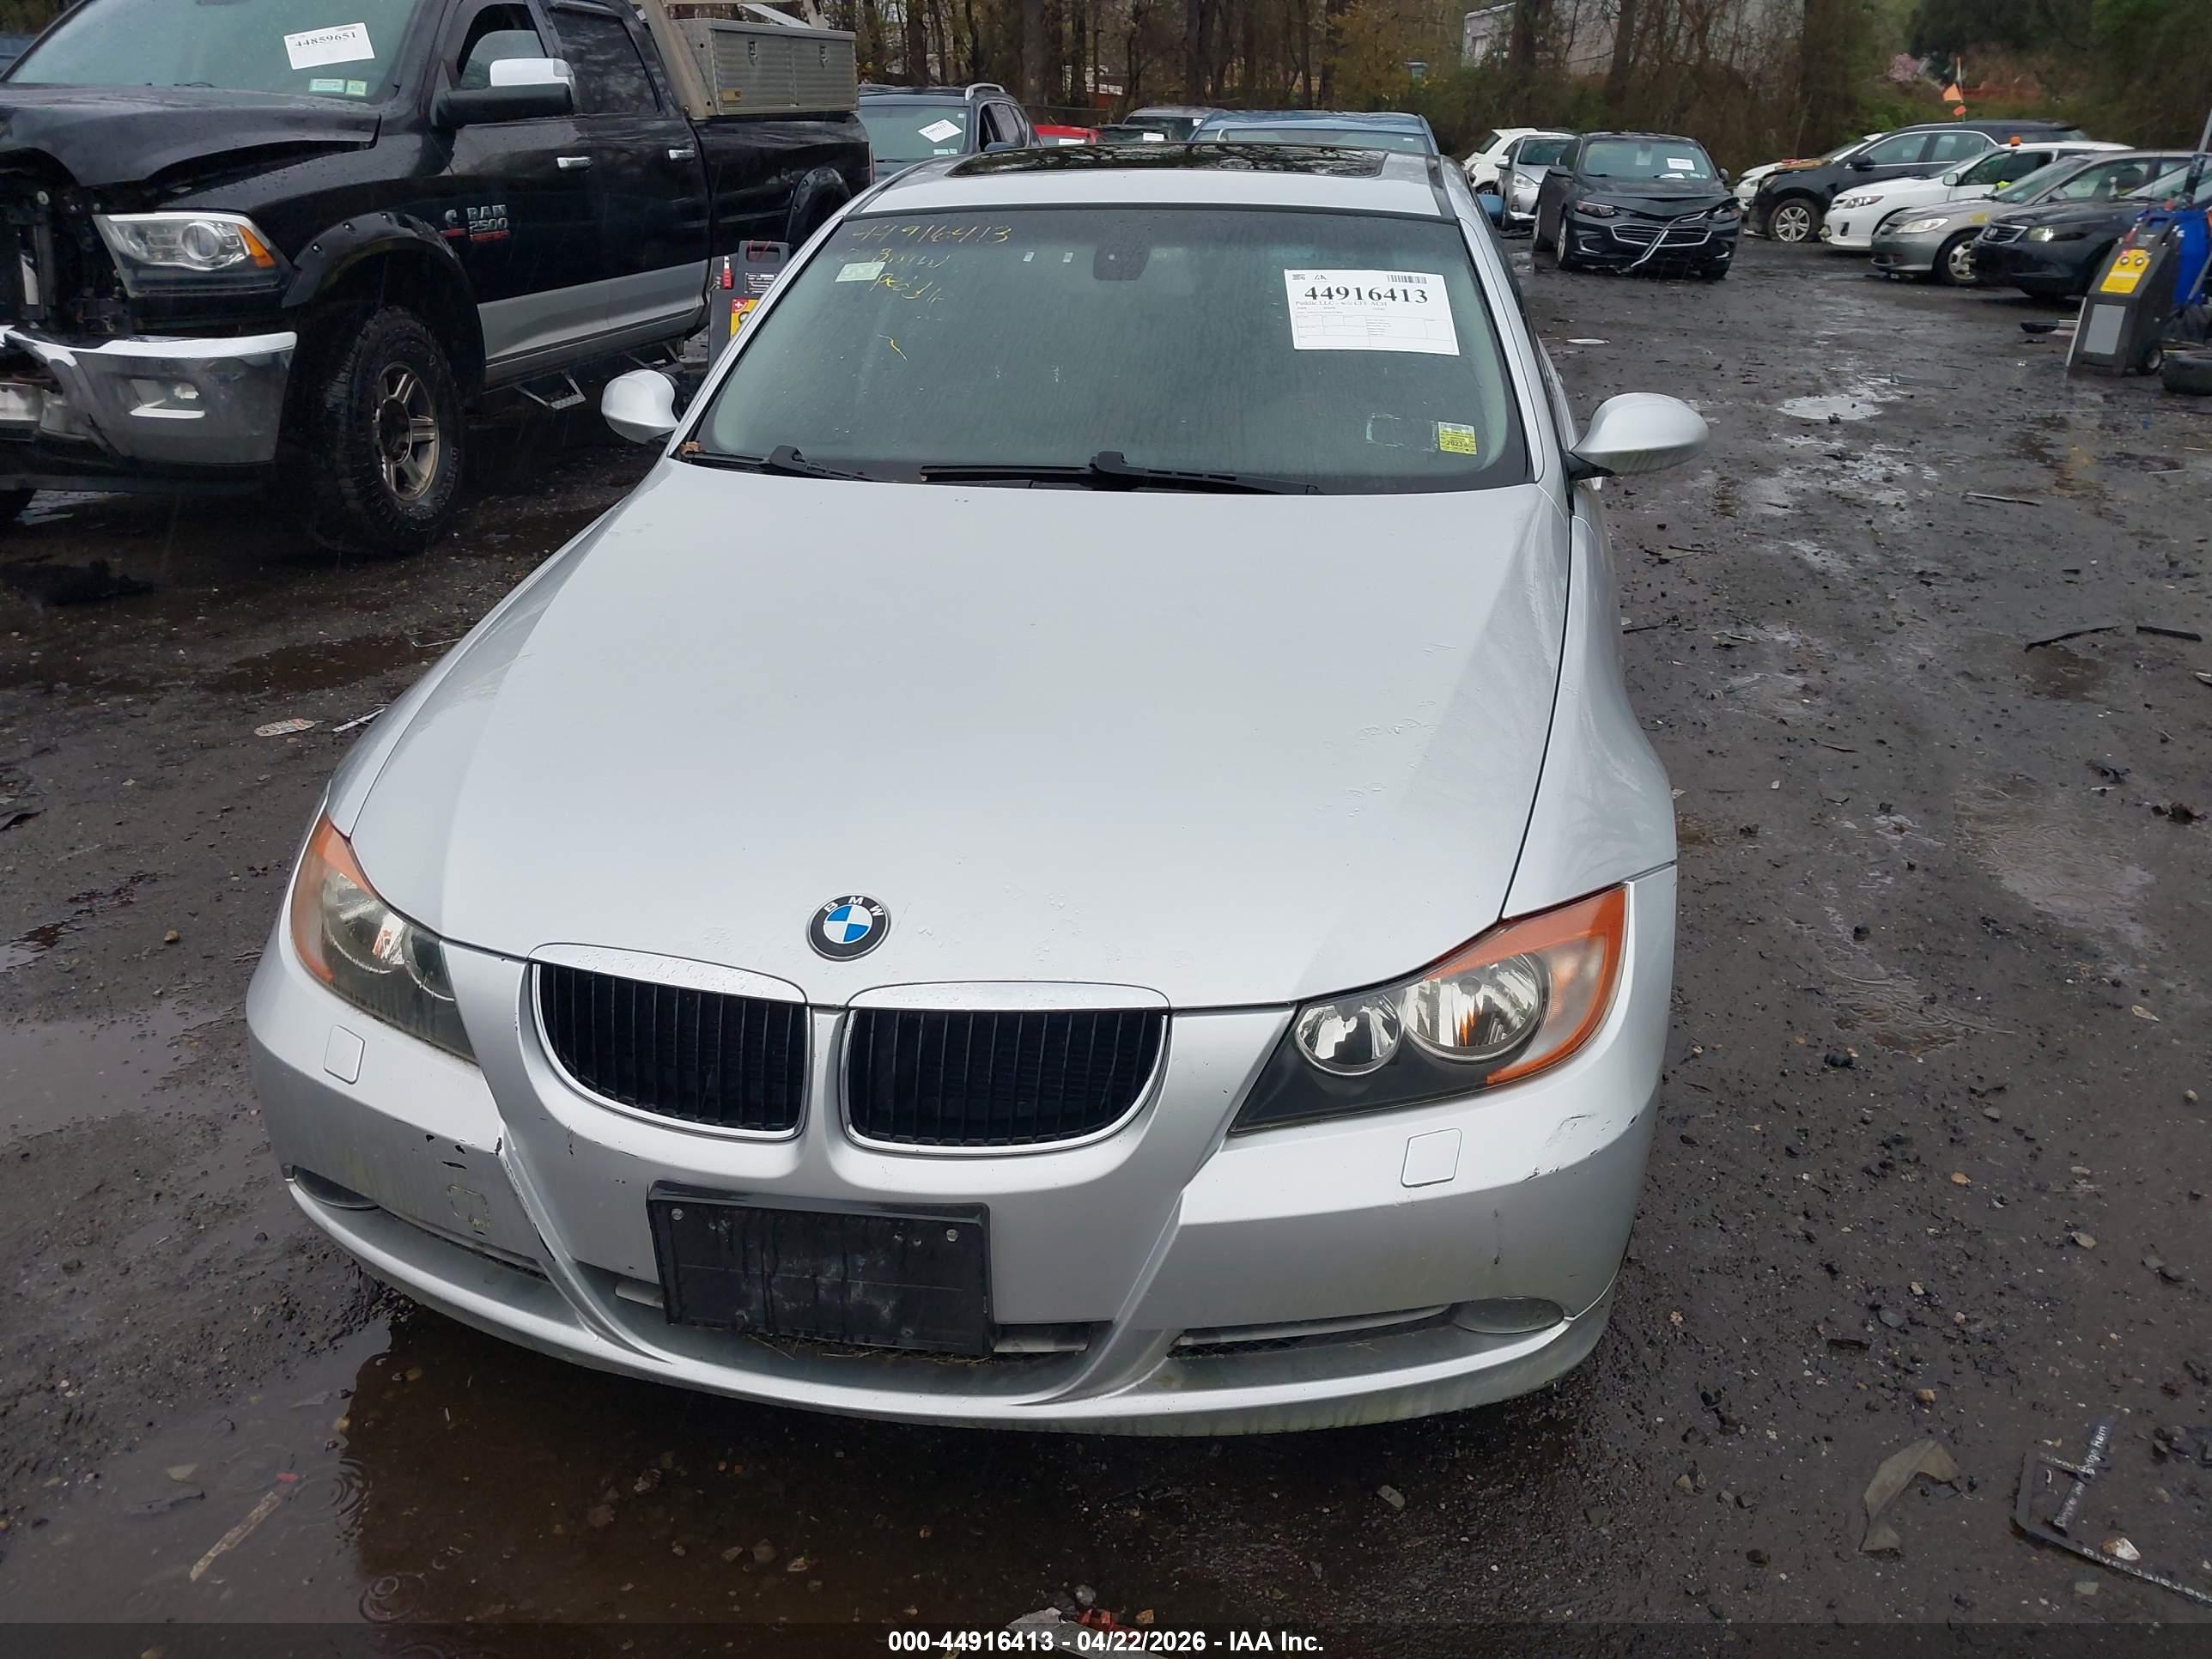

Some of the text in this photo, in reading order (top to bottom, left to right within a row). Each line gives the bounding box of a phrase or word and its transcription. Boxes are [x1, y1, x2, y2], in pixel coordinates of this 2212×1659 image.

[295, 31, 357, 47] 44859651
[466, 204, 507, 221] RAM
[469, 217, 508, 232] 2500
[1304, 286, 1428, 304] 44916413
[823, 896, 884, 917] BMW
